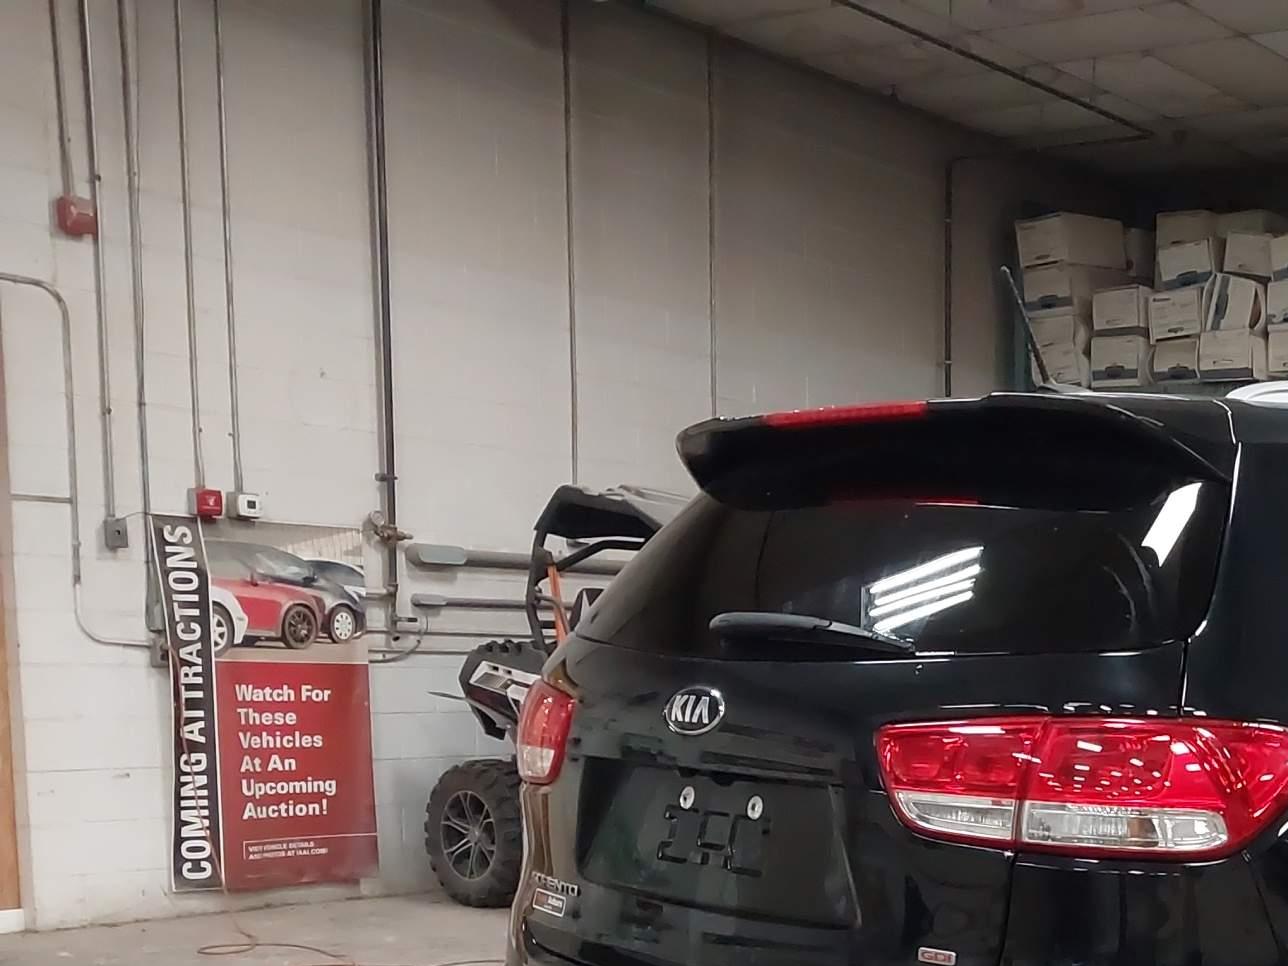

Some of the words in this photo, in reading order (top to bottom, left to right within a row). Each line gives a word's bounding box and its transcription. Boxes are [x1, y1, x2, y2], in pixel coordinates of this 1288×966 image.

[163, 525, 205, 745] ATTRACTIONS
[235, 684, 295, 702] Watch
[301, 684, 332, 702] For
[237, 707, 297, 725] These
[671, 694, 710, 724] KIA
[238, 731, 324, 749] Vehicles
[240, 755, 262, 773] At
[267, 754, 297, 772] An
[241, 776, 337, 799] Upcoming
[179, 752, 213, 880] COMING
[242, 798, 328, 820] Auction!
